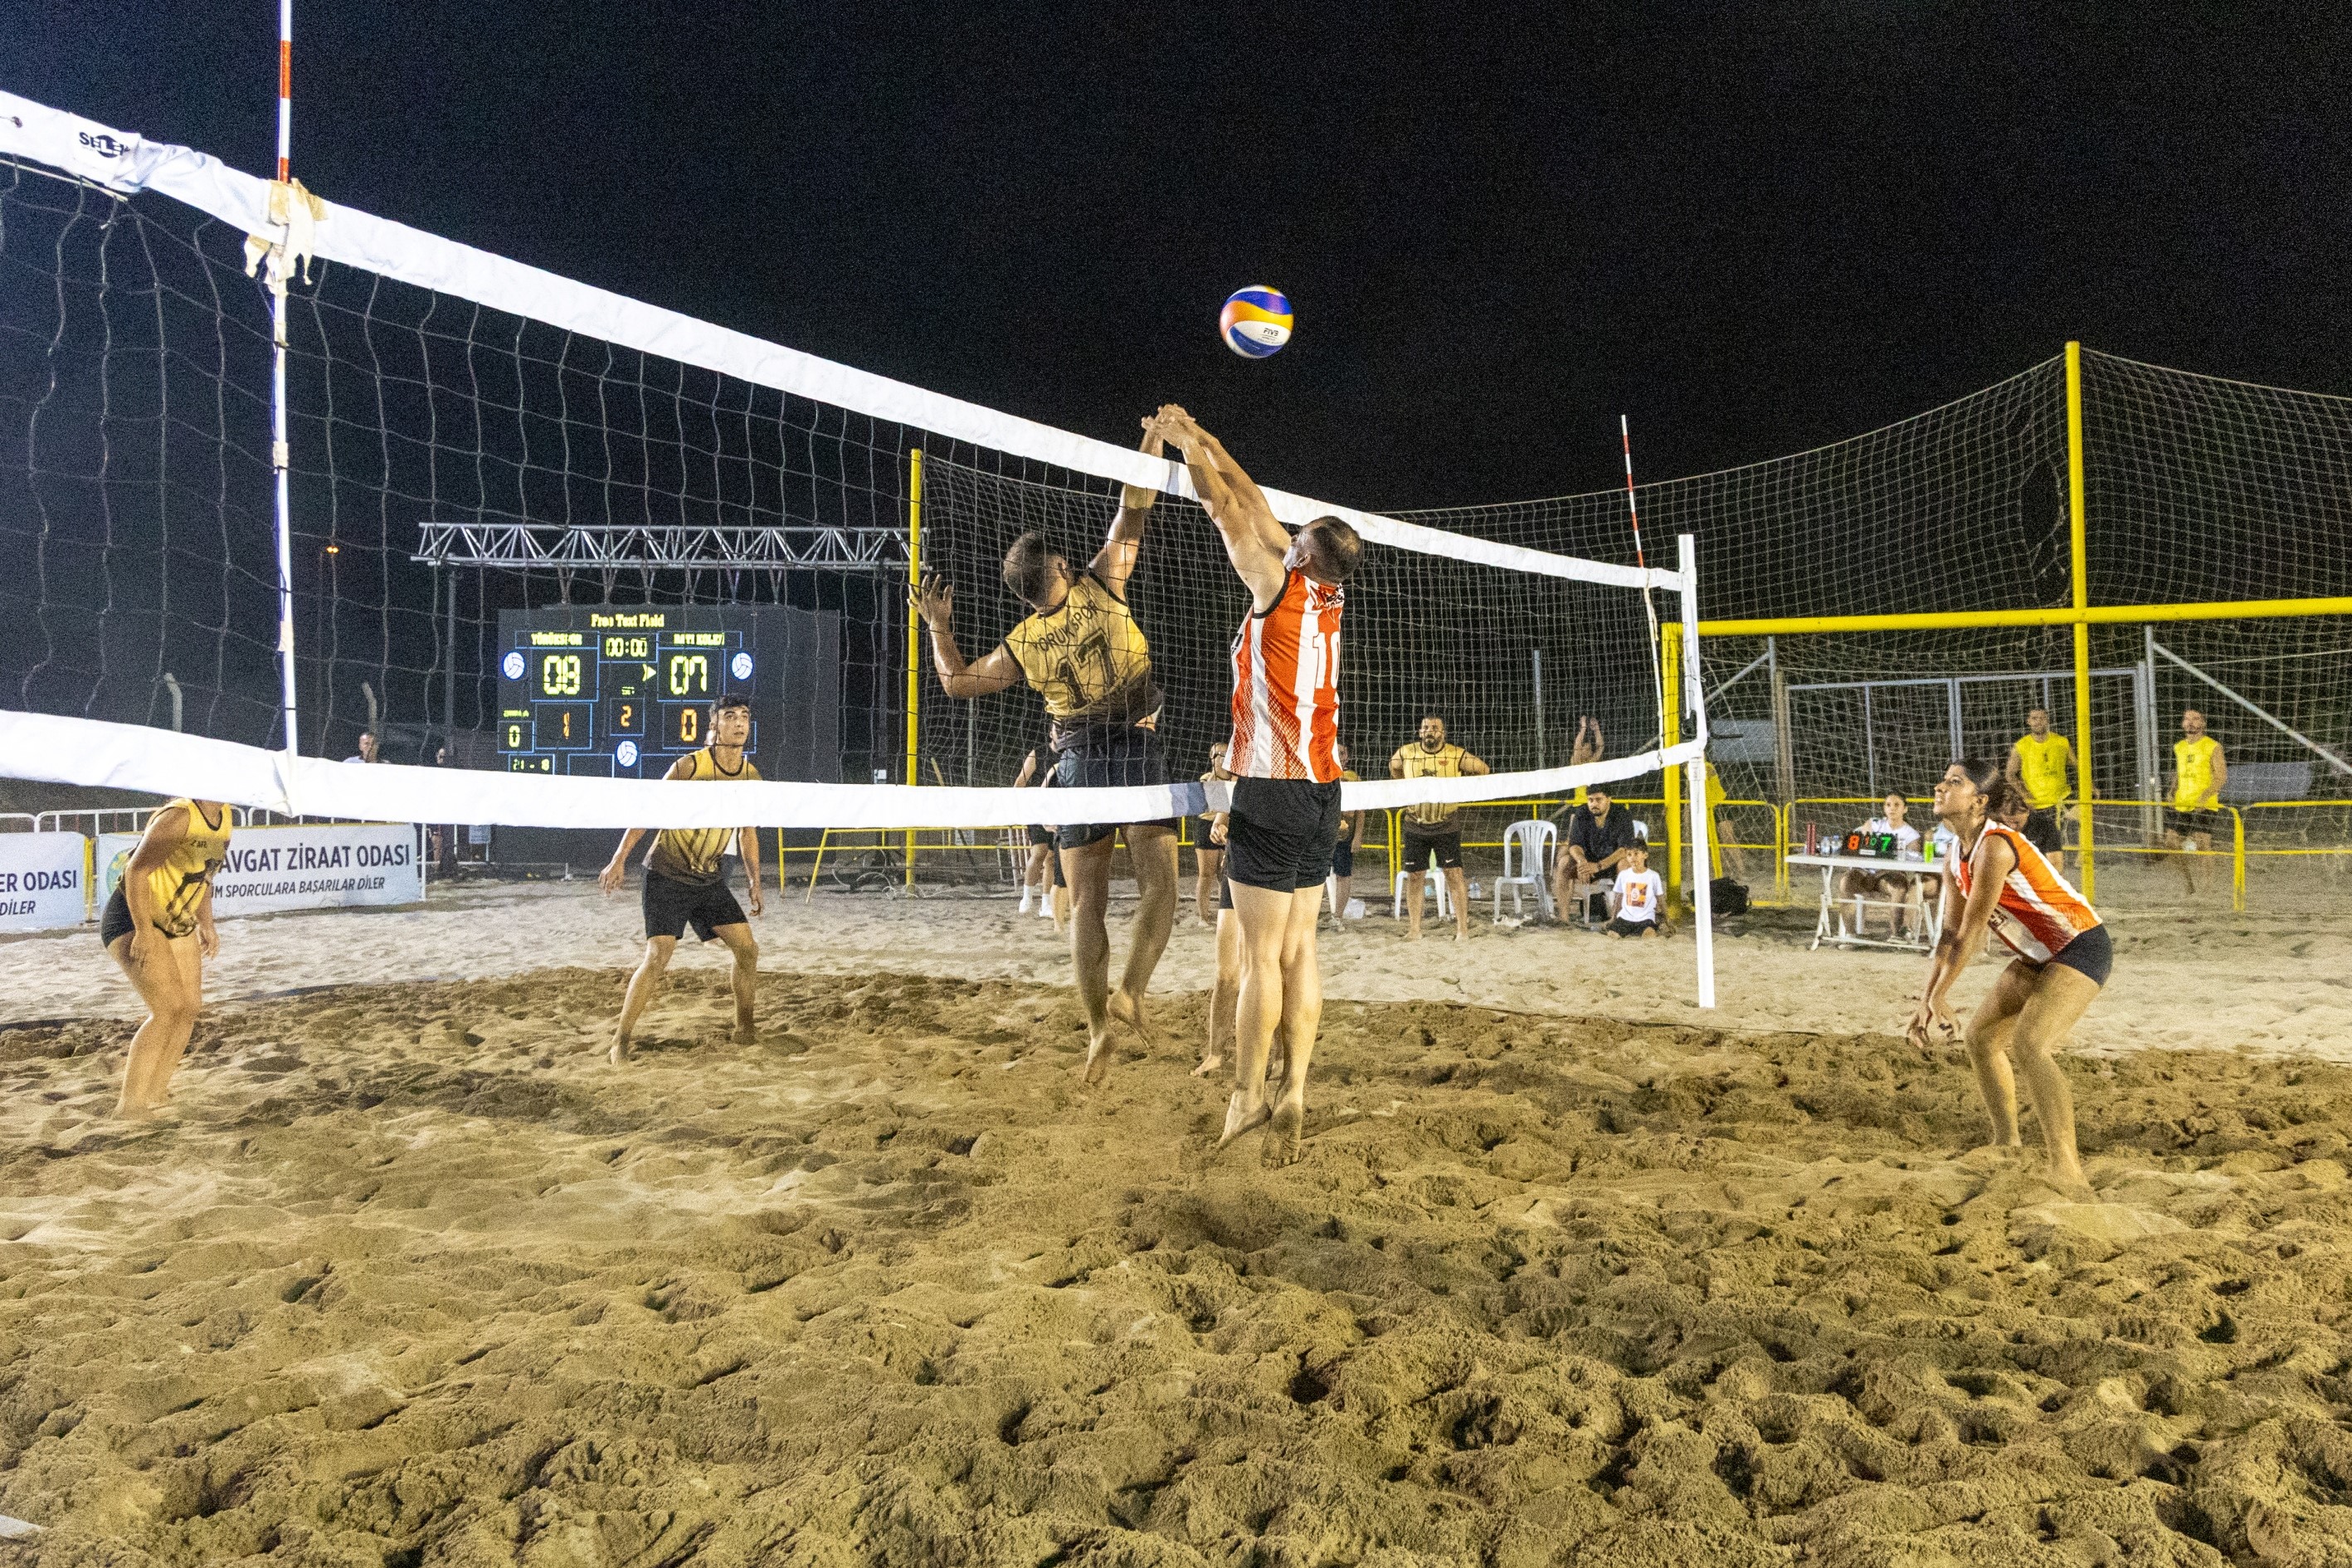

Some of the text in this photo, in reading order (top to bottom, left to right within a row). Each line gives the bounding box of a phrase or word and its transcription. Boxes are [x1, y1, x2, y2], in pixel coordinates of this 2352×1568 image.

[615, 614, 637, 627] Text
[606, 637, 647, 657] 00:00
[543, 655, 581, 695] 08
[670, 655, 708, 695] 07
[1055, 627, 1119, 711] 17
[562, 712, 571, 740] 1
[621, 705, 632, 728] 2
[680, 709, 698, 742] 0
[509, 724, 520, 747] 0
[1848, 835, 1860, 850] 8
[1881, 836, 1892, 852] 7
[286, 842, 351, 870] ZİRAAT
[357, 844, 410, 868] ODASI
[23, 869, 77, 891] ODASI
[226, 881, 295, 898] SPORCULARA
[299, 879, 355, 894] BAŞARILAR
[358, 874, 386, 890] DİLER
[0, 899, 36, 917] DİLER
